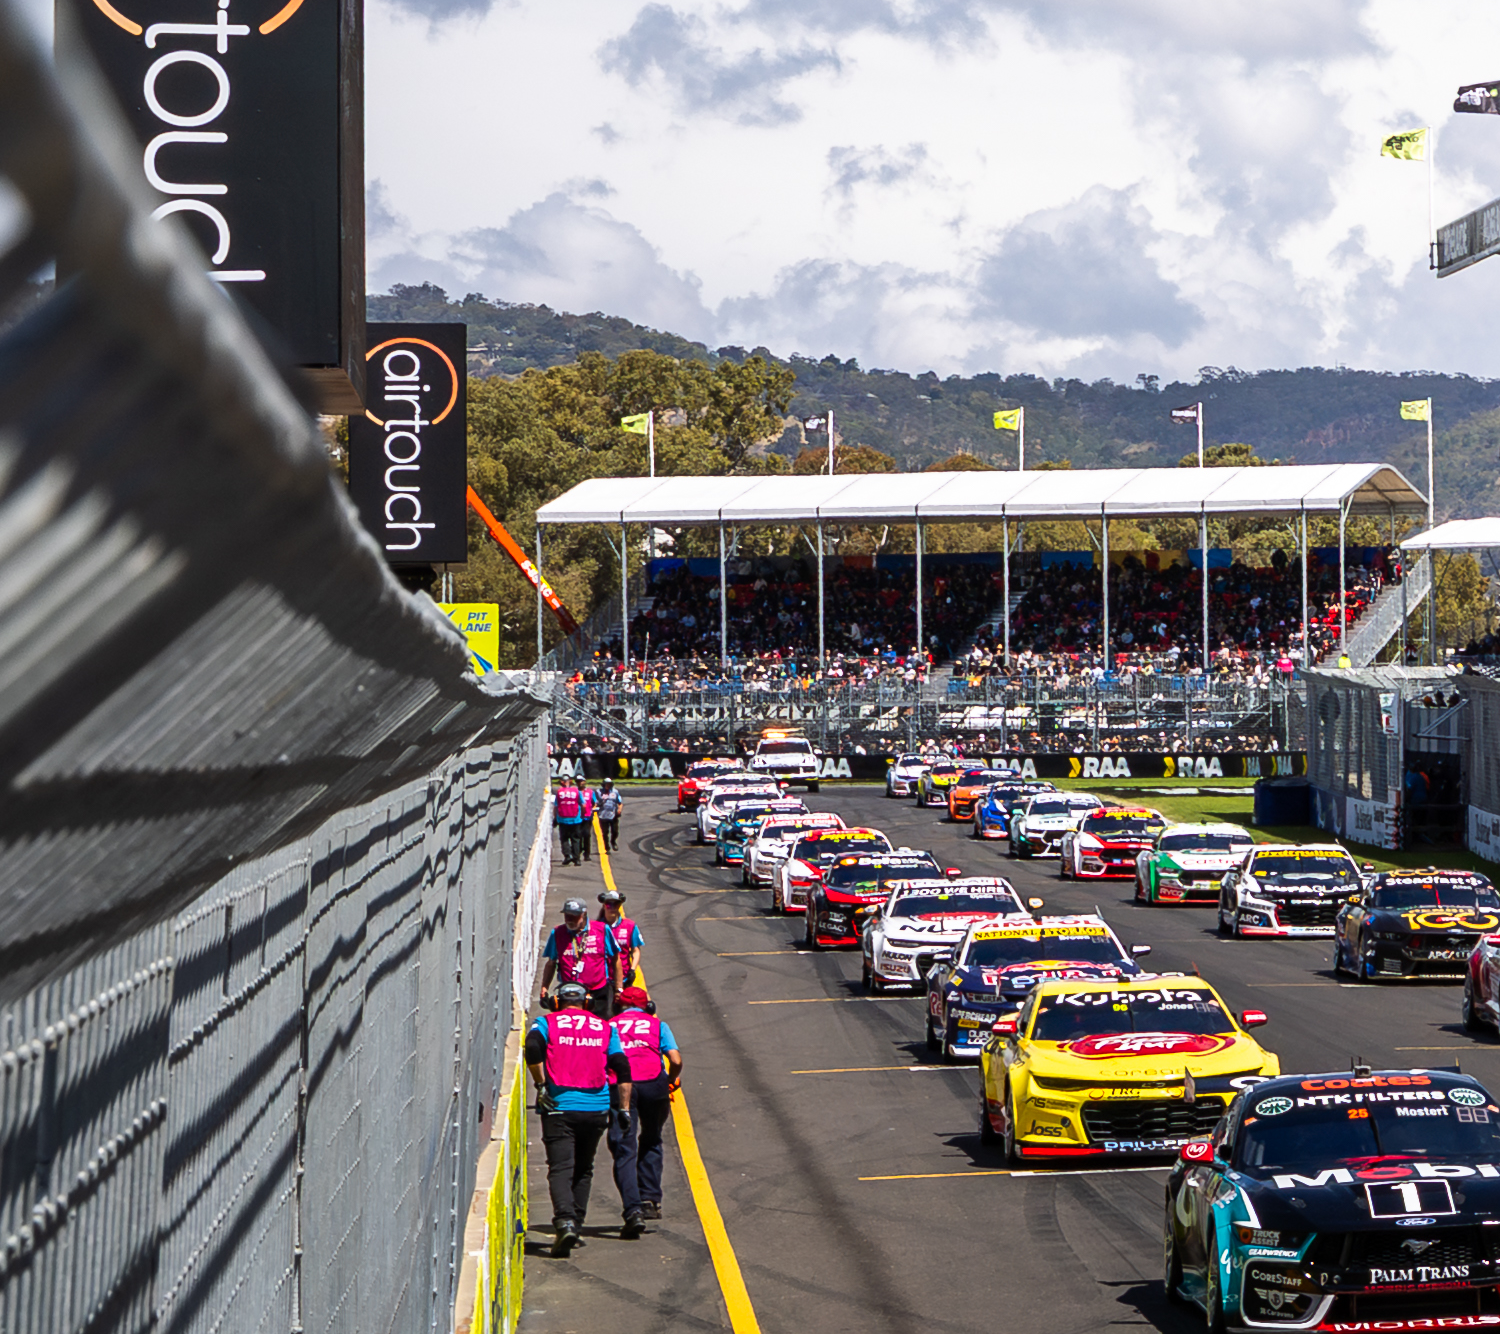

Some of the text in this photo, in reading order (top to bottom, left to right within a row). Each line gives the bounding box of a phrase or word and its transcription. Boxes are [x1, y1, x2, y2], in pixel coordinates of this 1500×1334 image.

[383, 349, 435, 551] airtouch
[468, 612, 488, 621] PIT
[459, 623, 492, 632] LANE
[632, 758, 674, 777] RAA
[1083, 757, 1131, 778] RAA
[1178, 757, 1223, 778] RAA
[1386, 876, 1464, 885] Steadfast
[948, 886, 1005, 895] WE HIRE
[1159, 887, 1184, 896] RYCO
[1401, 913, 1498, 929] 100
[974, 928, 1108, 939] NATIONAL STORAGE
[880, 963, 910, 973] ISUZU
[1055, 989, 1202, 1006] Kubota
[1158, 1002, 1194, 1011] Jones
[950, 1008, 997, 1022] SUPERCHEAP
[556, 1015, 603, 1031] 275
[559, 1036, 603, 1047] PIT LANE
[1301, 1076, 1431, 1090] Coates
[1297, 1091, 1446, 1107] NTK FILTERS
[1348, 1104, 1449, 1119] 25 Mostert
[1025, 1121, 1063, 1137] Joss
[1391, 1183, 1421, 1213] 1
[1252, 1229, 1281, 1240] TRUCK
[1251, 1237, 1280, 1247] ASSIST
[1248, 1248, 1299, 1258] GEARWRENCH
[1370, 1265, 1469, 1284] PALM TRANS
